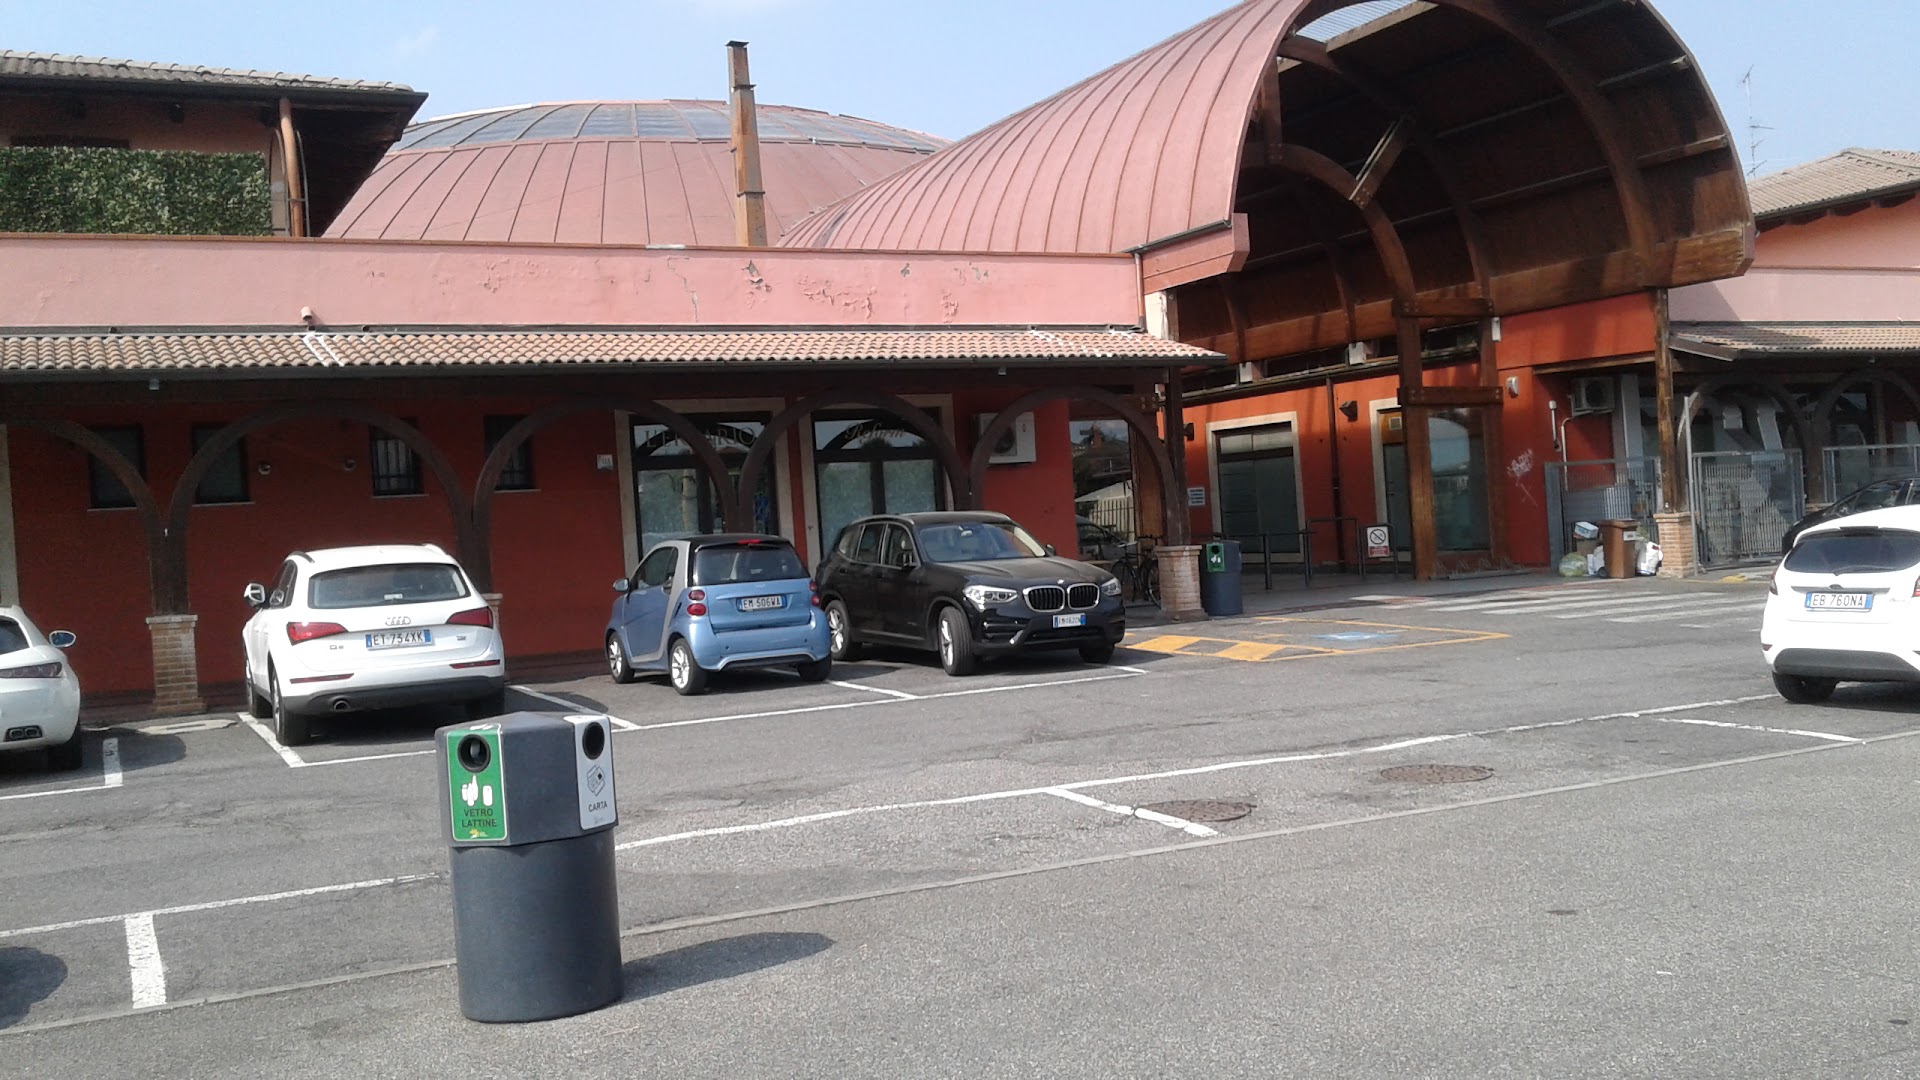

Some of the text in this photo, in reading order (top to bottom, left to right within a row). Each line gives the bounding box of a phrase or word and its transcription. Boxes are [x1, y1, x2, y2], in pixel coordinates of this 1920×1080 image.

[743, 597, 780, 608] EM 506WA
[1813, 594, 1863, 606] EB 760NA
[373, 634, 387, 646] ET
[464, 808, 493, 817] VETRO
[588, 801, 608, 813] CARTA
[462, 818, 497, 828] LATTINE
